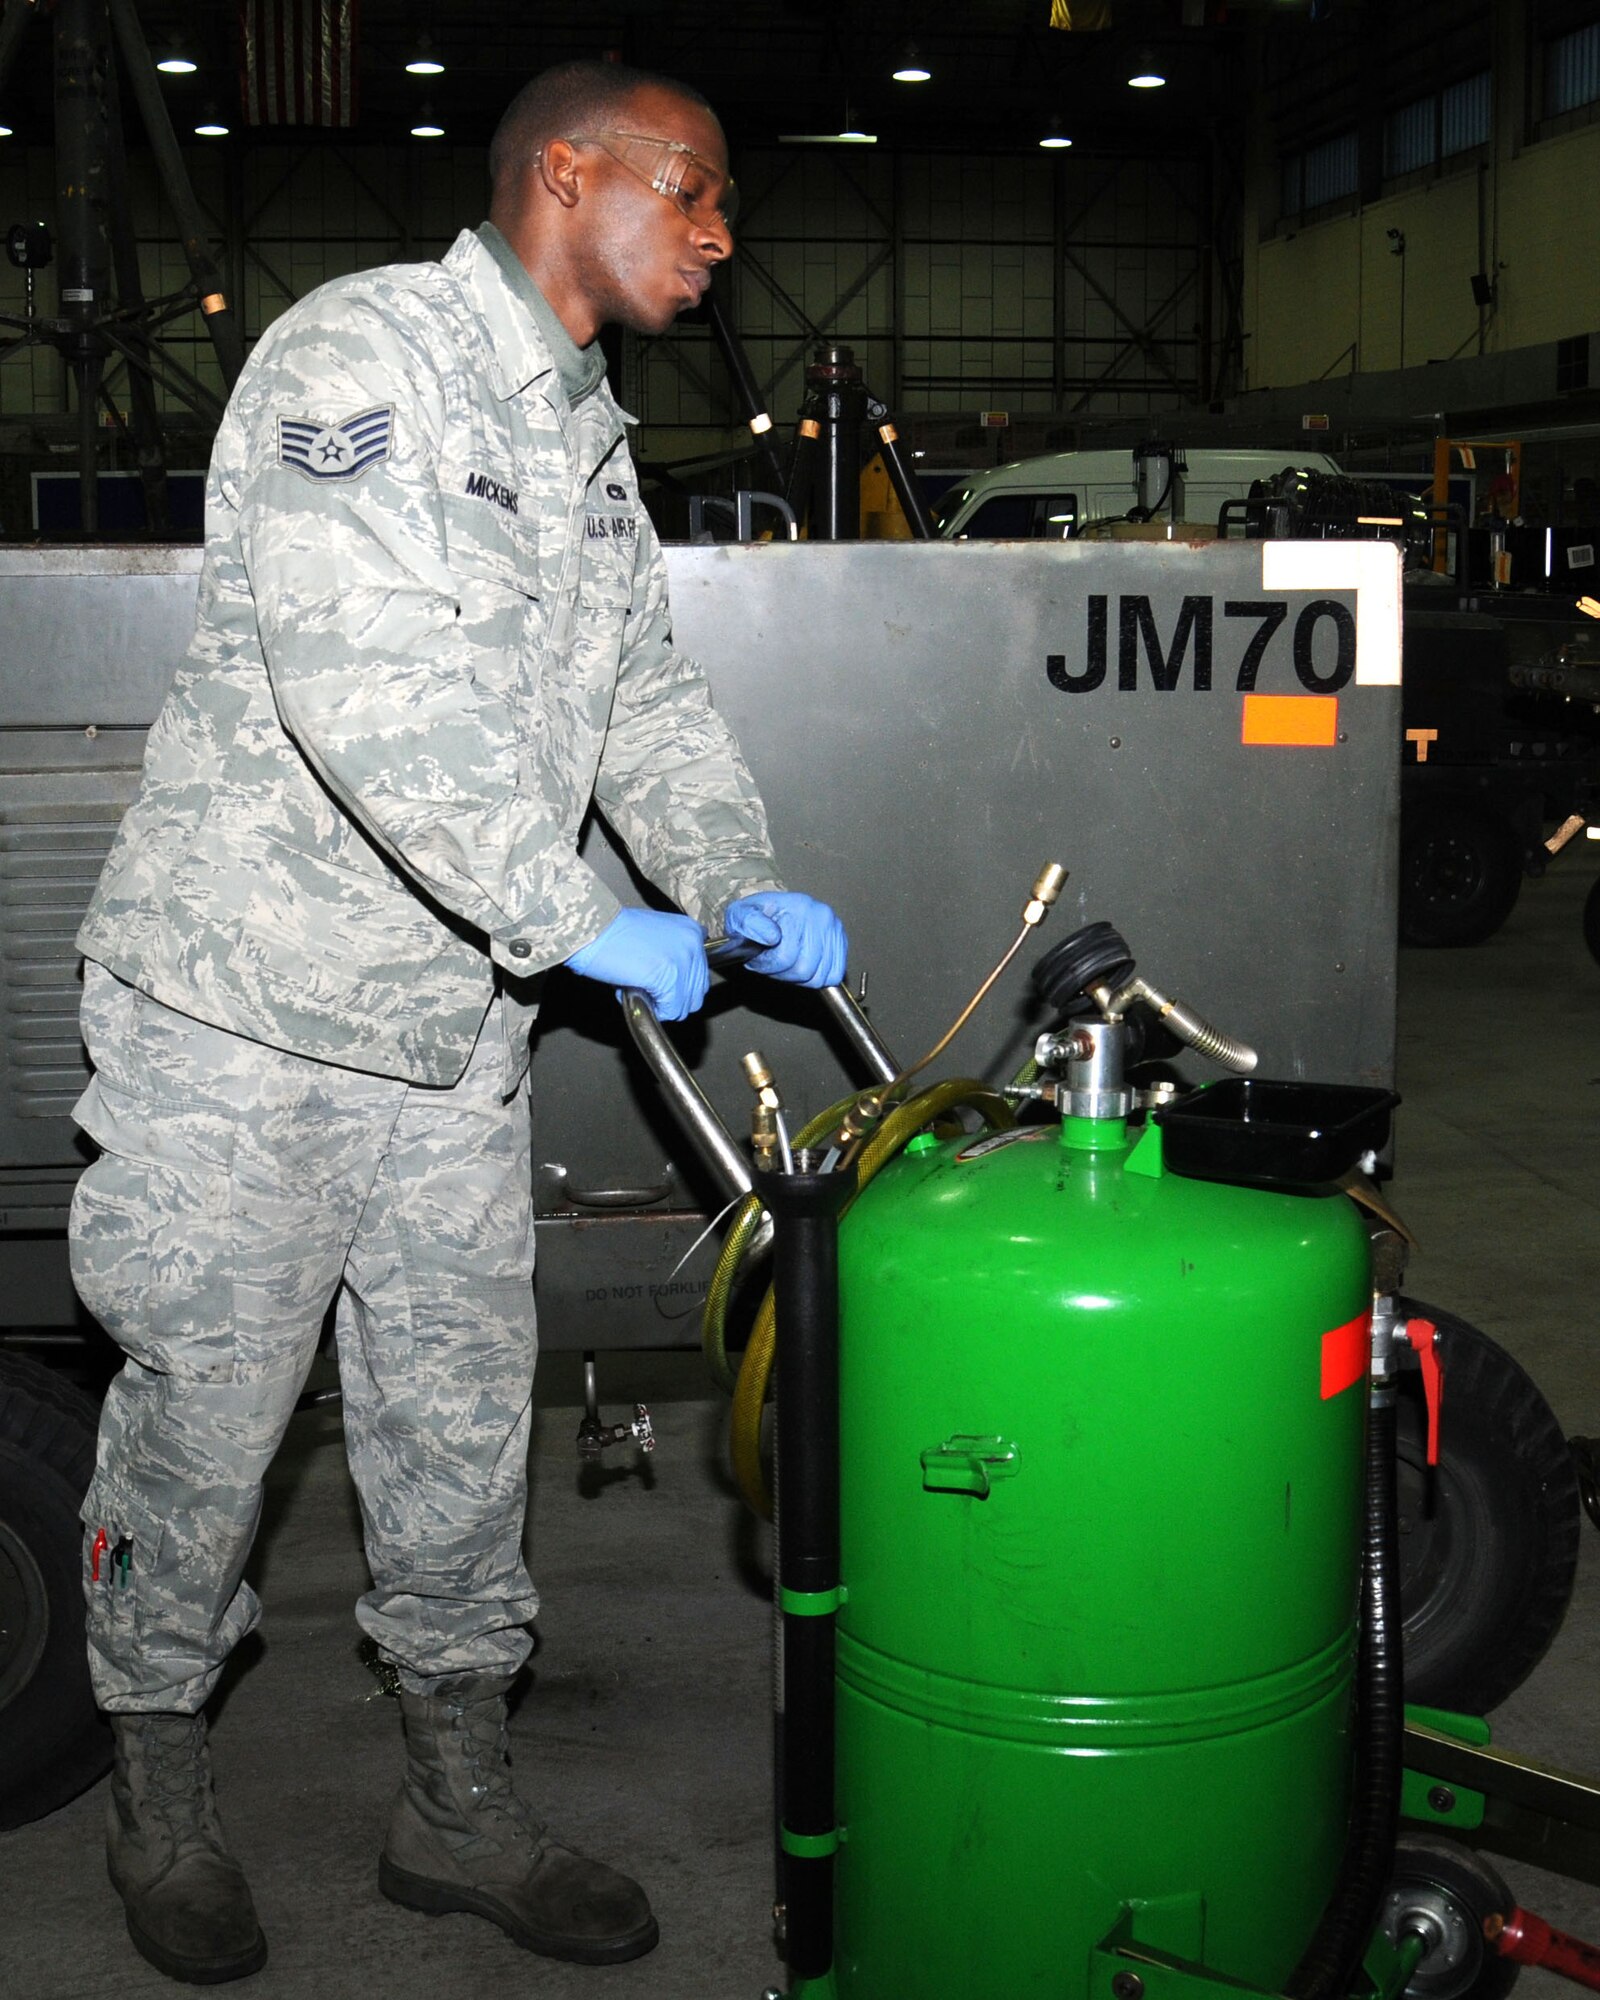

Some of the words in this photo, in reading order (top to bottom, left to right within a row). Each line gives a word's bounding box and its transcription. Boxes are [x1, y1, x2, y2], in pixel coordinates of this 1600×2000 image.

[465, 472, 519, 515] MICKENS
[587, 517, 609, 538] U.S.
[612, 517, 628, 538] AIR
[1047, 594, 1357, 694] JM70
[585, 1288, 607, 1301] DO
[612, 1285, 644, 1299] NOT
[648, 1281, 711, 1297] FORKLIF
